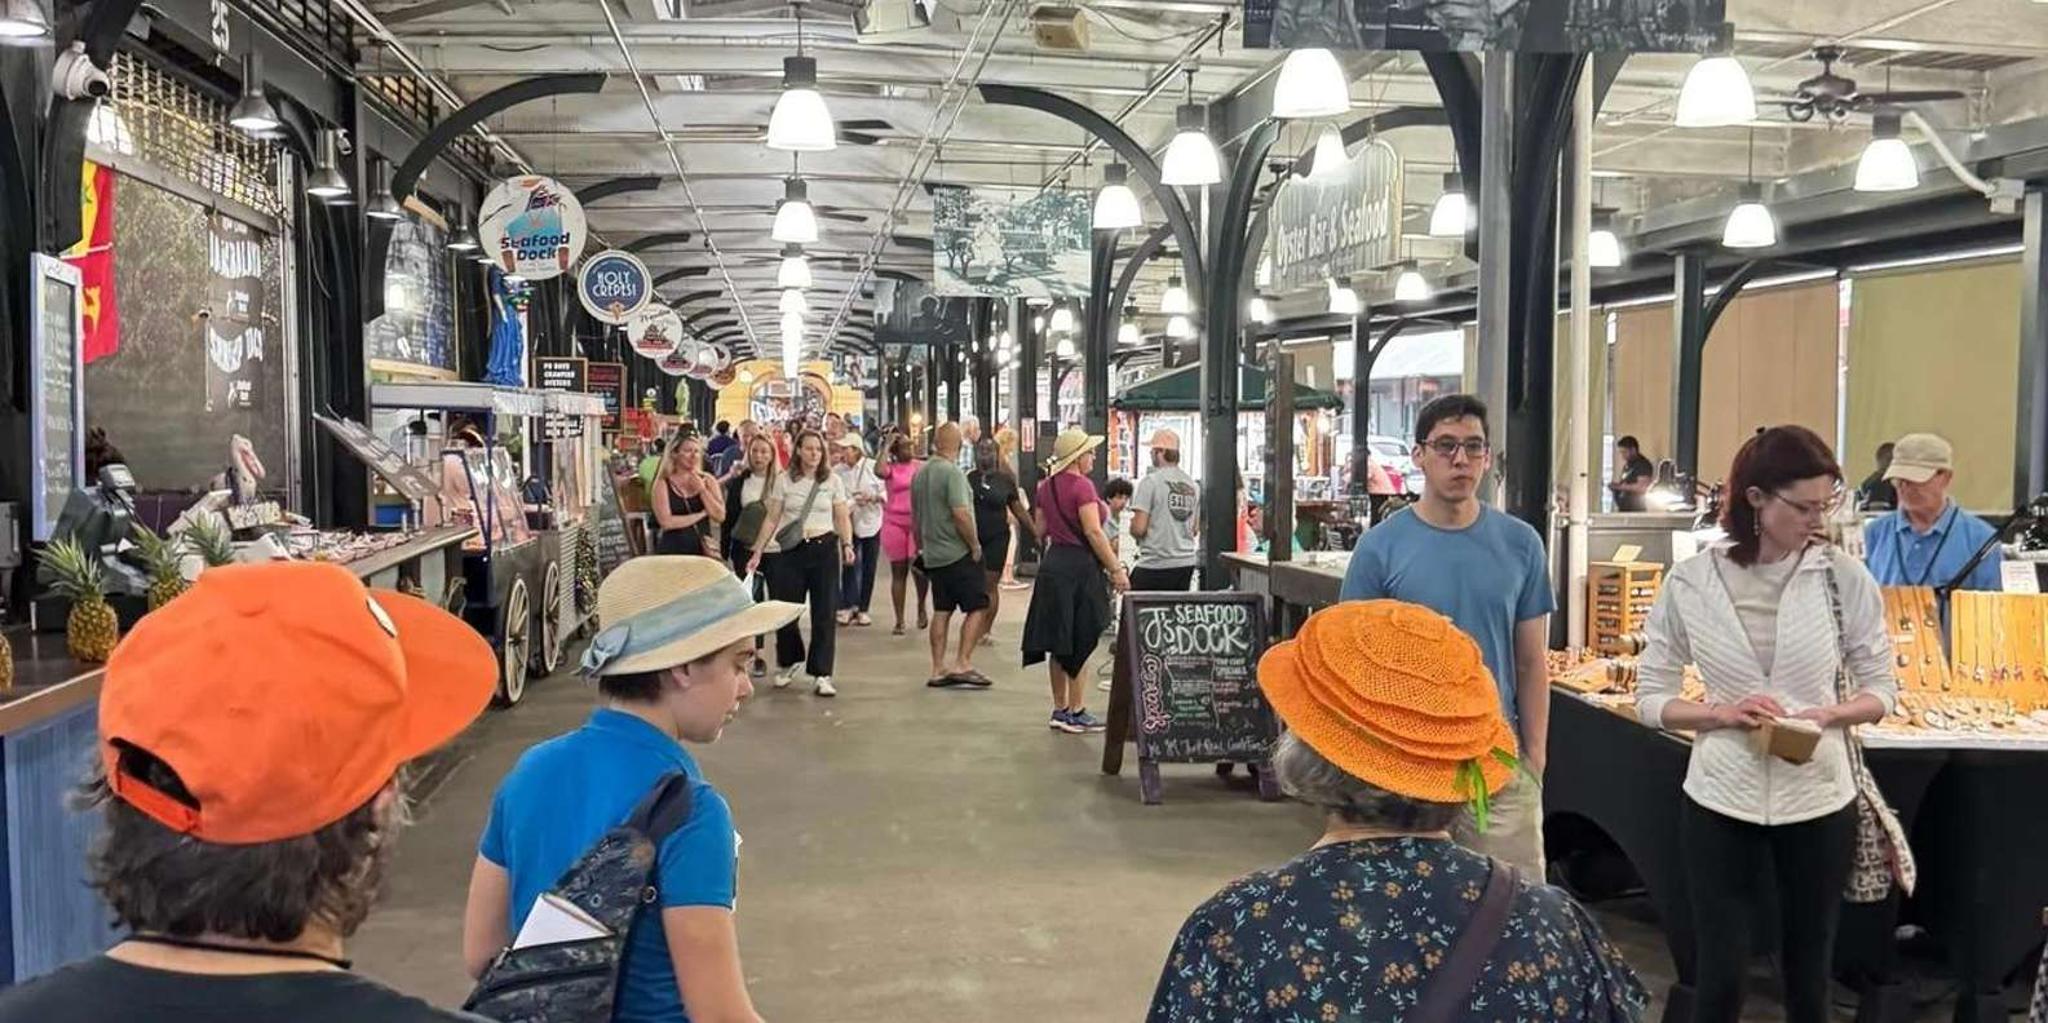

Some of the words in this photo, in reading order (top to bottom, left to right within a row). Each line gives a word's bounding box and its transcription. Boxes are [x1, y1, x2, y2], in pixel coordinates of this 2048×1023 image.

[1277, 223, 1307, 277] Oyster
[1340, 183, 1390, 249] Seafood
[501, 233, 570, 249] Seafood
[516, 248, 557, 261] Dock
[597, 271, 631, 285] HOLY
[592, 283, 637, 297] CREPES!
[1174, 604, 1247, 624] SEAFOOD
[1176, 623, 1250, 655] DOCK
